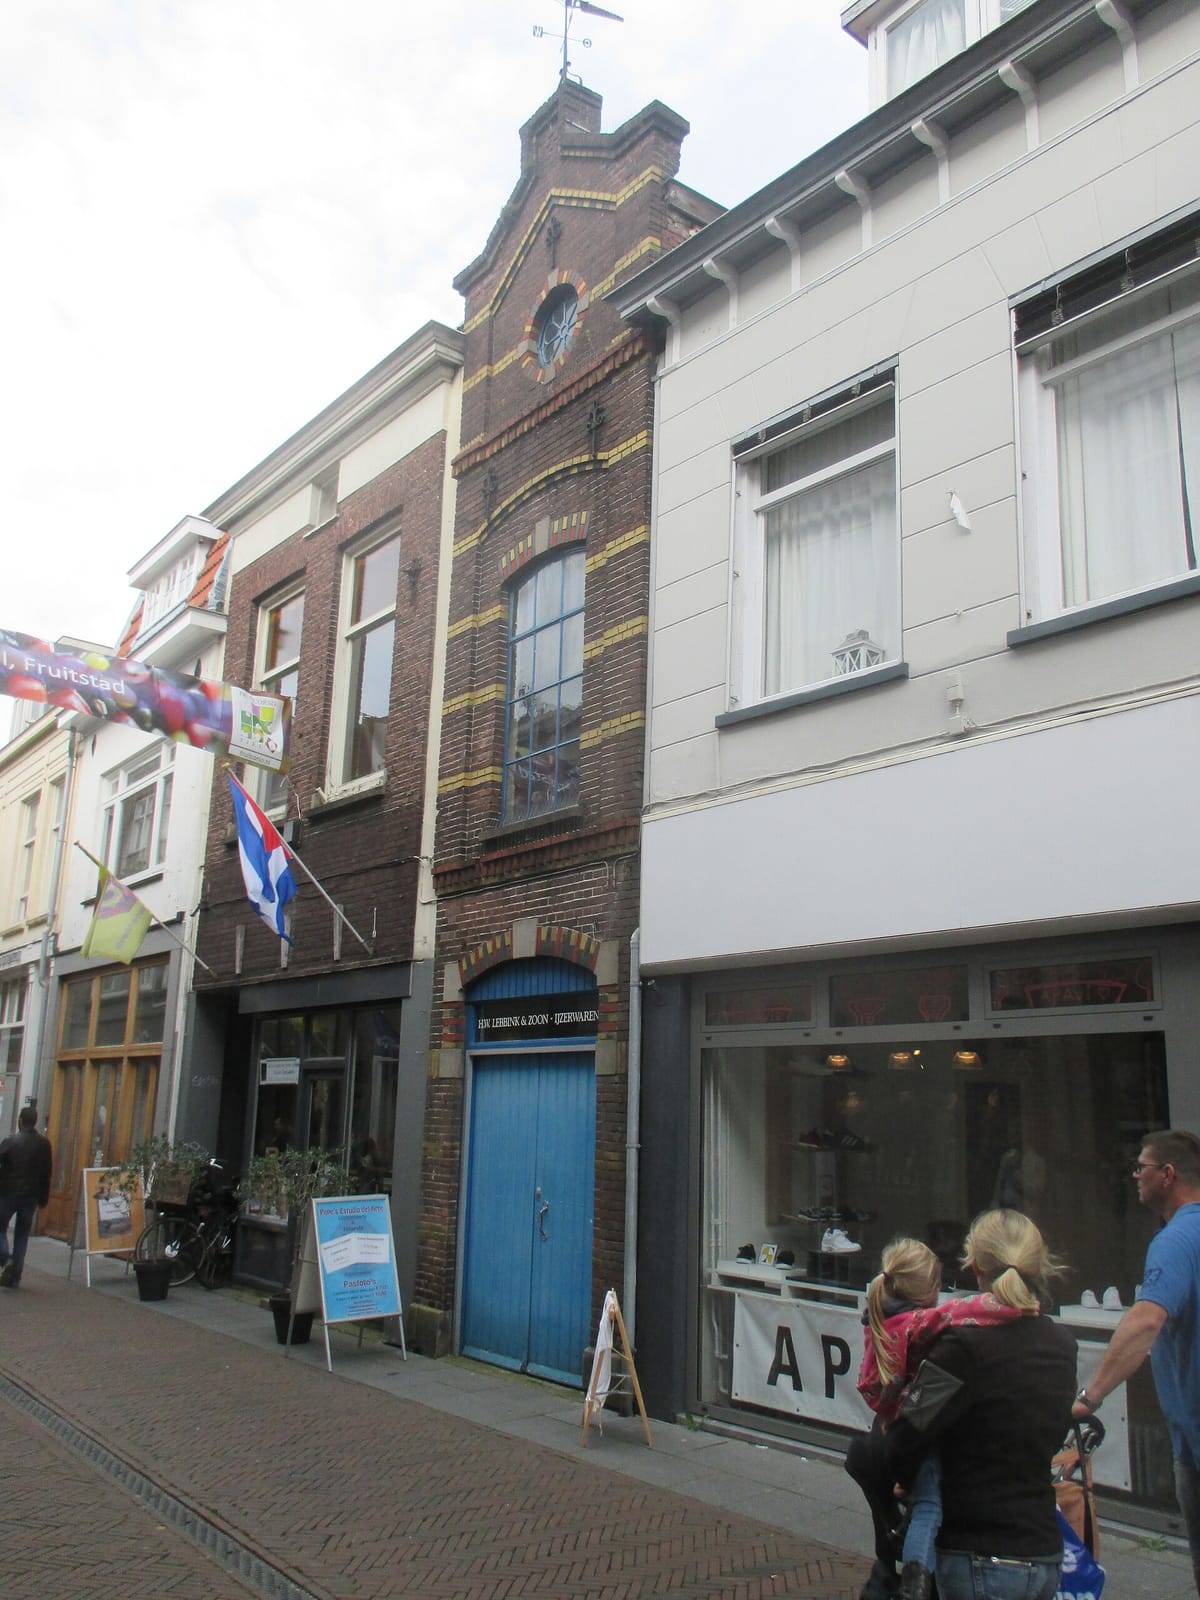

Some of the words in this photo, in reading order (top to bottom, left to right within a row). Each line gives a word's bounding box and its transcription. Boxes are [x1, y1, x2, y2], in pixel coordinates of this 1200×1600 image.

[24, 656, 126, 695] Fruitstad
[492, 1016, 520, 1028] LEBBINK
[520, 1015, 528, 1026] &
[528, 1013, 549, 1026] ZOON
[554, 1010, 599, 1025] IJZERWAREN
